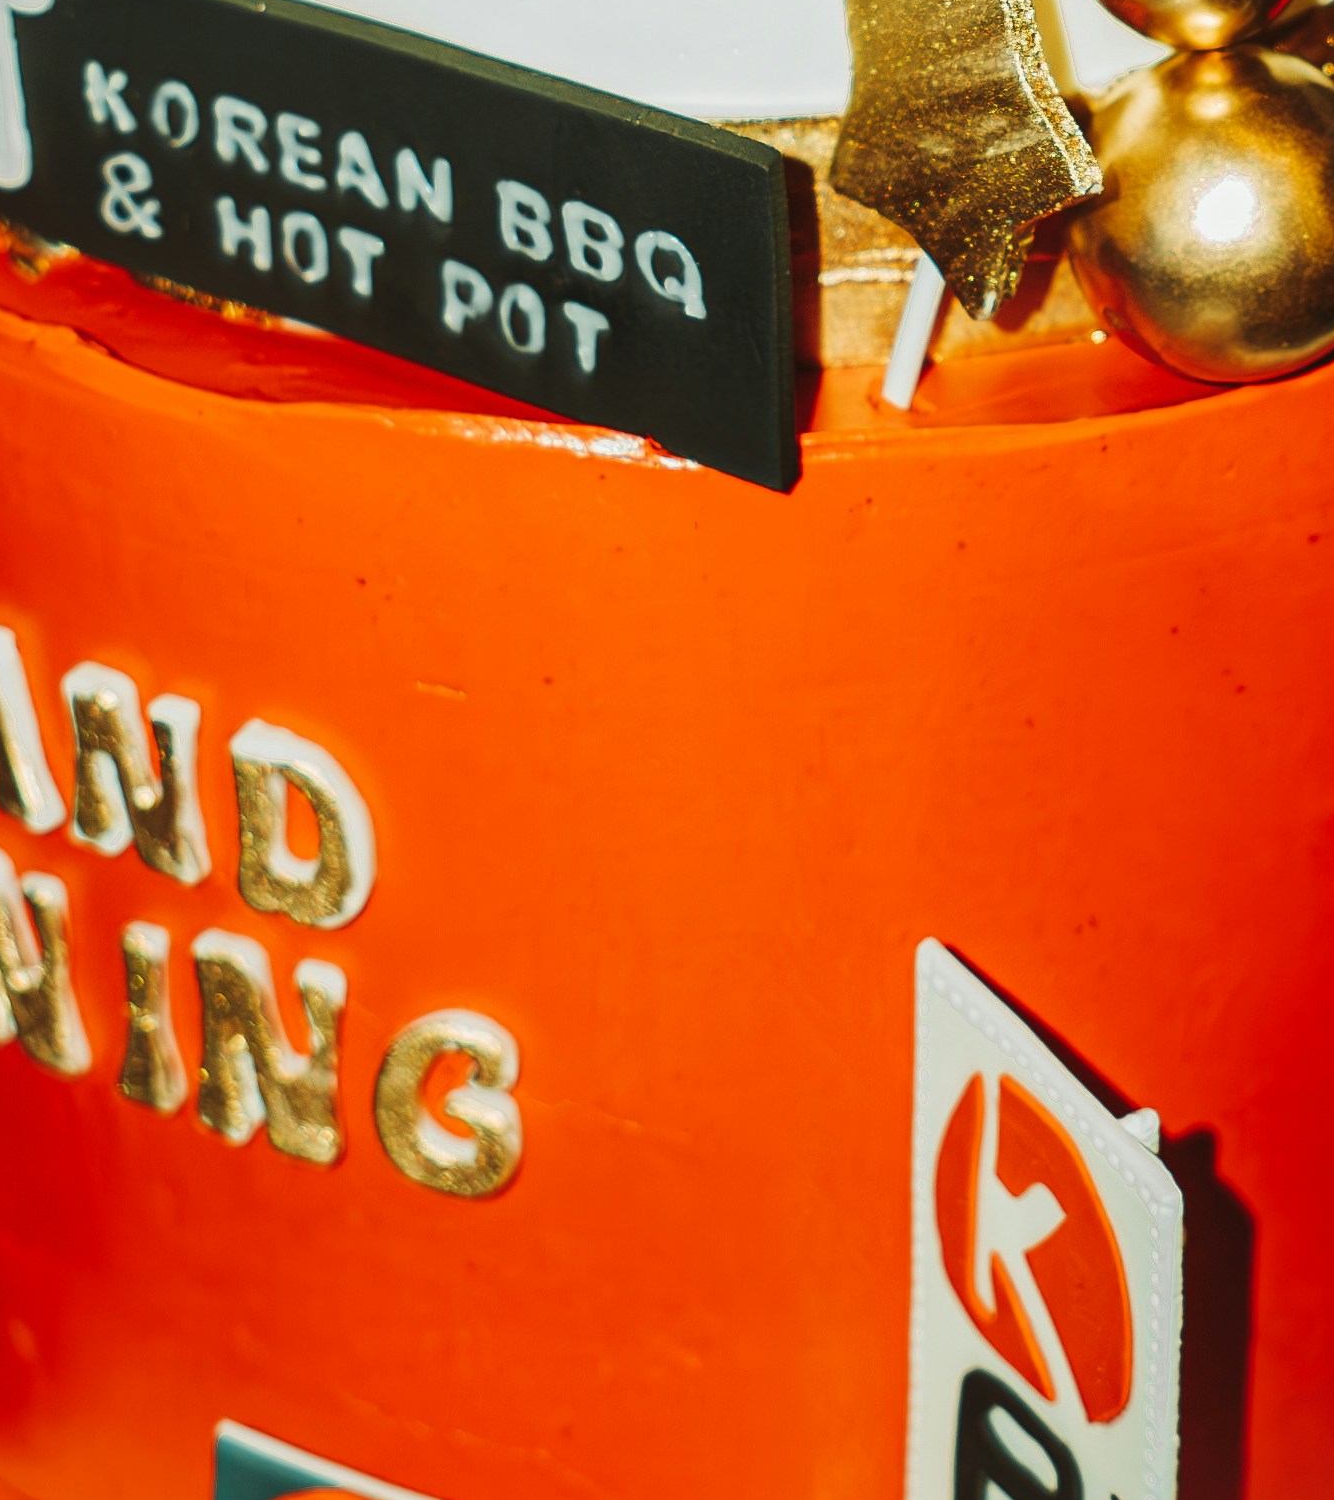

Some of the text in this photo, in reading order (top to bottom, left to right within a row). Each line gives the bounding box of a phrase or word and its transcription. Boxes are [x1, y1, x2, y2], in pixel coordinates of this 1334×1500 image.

[82, 60, 709, 322] KOREAN BBQ
[99, 152, 611, 376] & HOT POT
